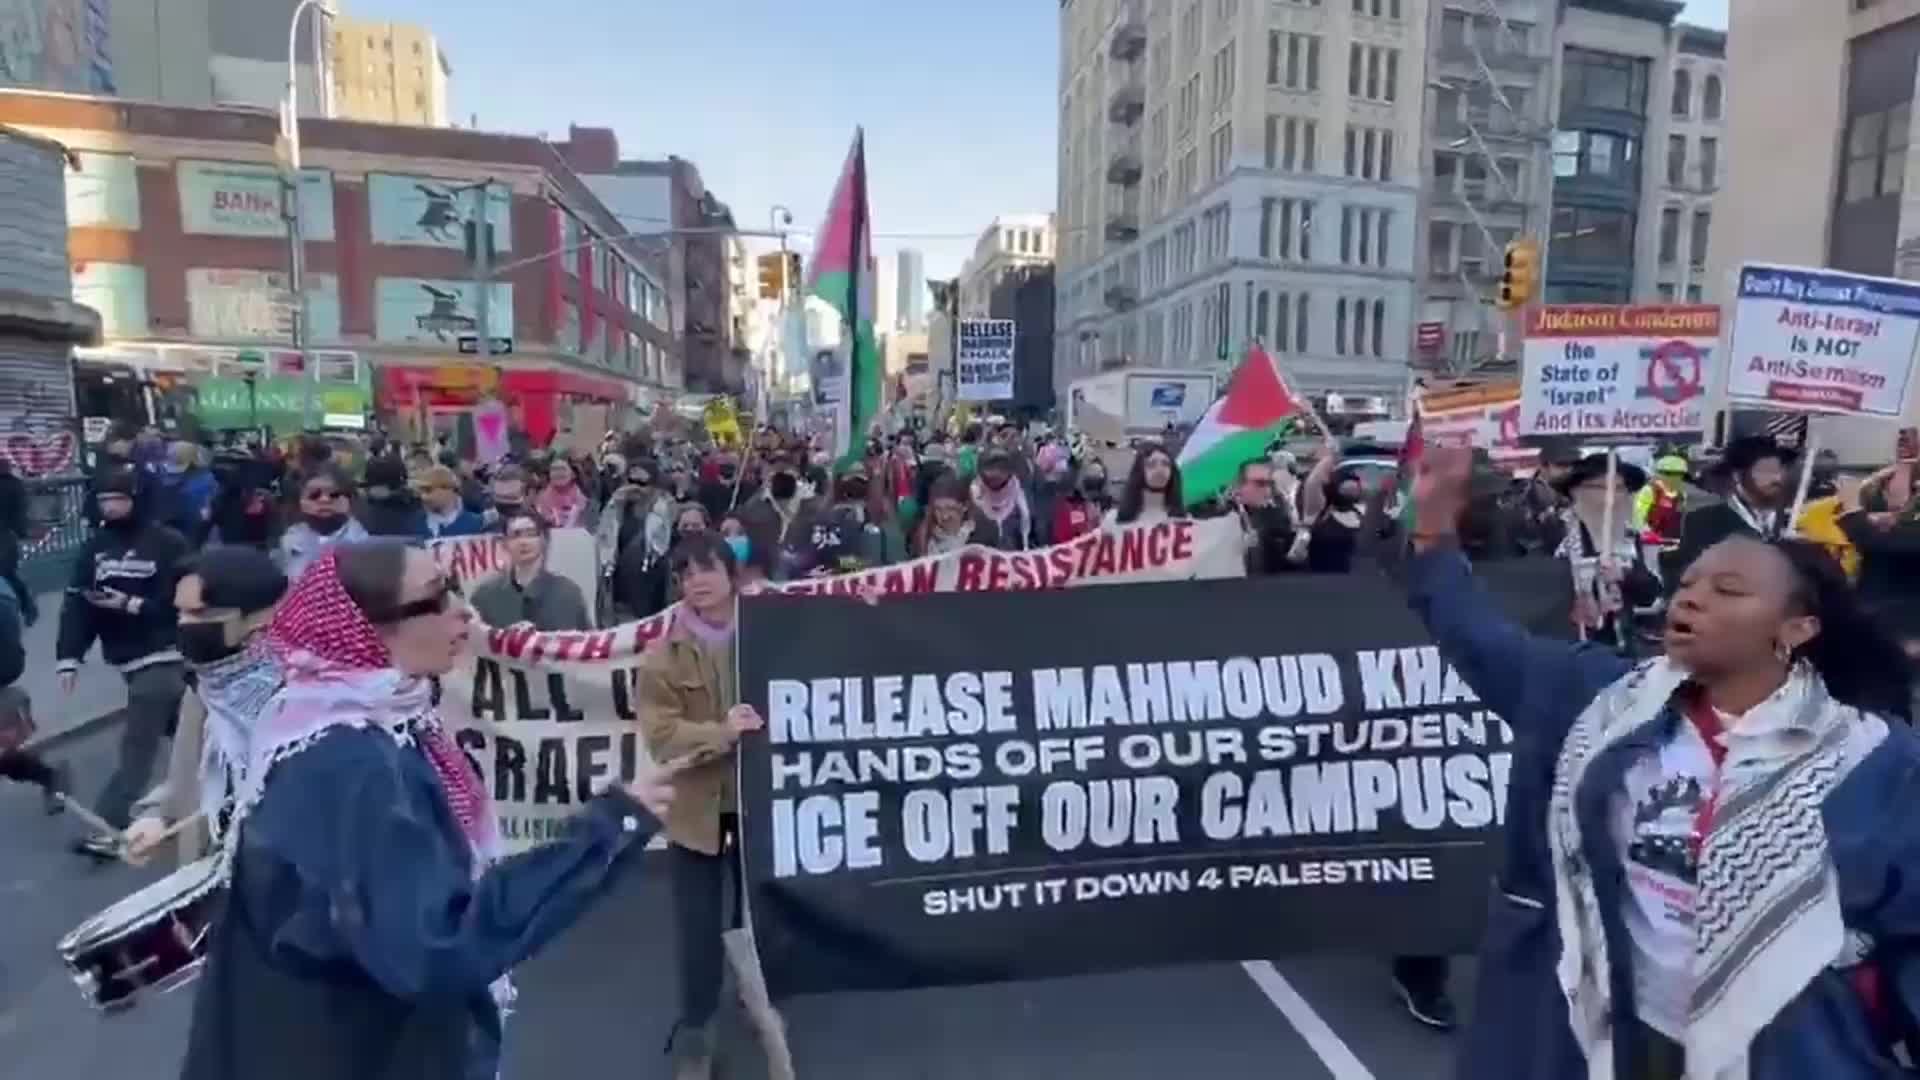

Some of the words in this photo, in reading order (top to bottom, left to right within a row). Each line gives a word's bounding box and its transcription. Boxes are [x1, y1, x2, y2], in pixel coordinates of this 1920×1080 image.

[960, 322, 1011, 336] RELEASE
[1536, 309, 1615, 331] Judaism
[1565, 341, 1596, 360] the
[1813, 337, 1861, 358] NOT
[1540, 365, 1590, 382] State
[1596, 363, 1619, 382] of
[1535, 411, 1571, 430] And
[955, 520, 1194, 592] RESISTANCE
[471, 656, 584, 722] ALL
[768, 671, 1017, 744] RELEASE
[1032, 652, 1345, 730] MAHMOUD
[771, 743, 982, 790] HANDS
[995, 736, 1105, 776] OFF
[1119, 727, 1247, 768] OUR
[773, 790, 882, 878] ICE
[902, 784, 1020, 863] OFF
[1041, 774, 1181, 851] OUR
[922, 882, 1027, 915] SHUT
[1035, 878, 1068, 905] IT
[1075, 868, 1190, 901] DOWN
[1198, 867, 1223, 890] 4
[1230, 857, 1435, 889] PALESTINE
